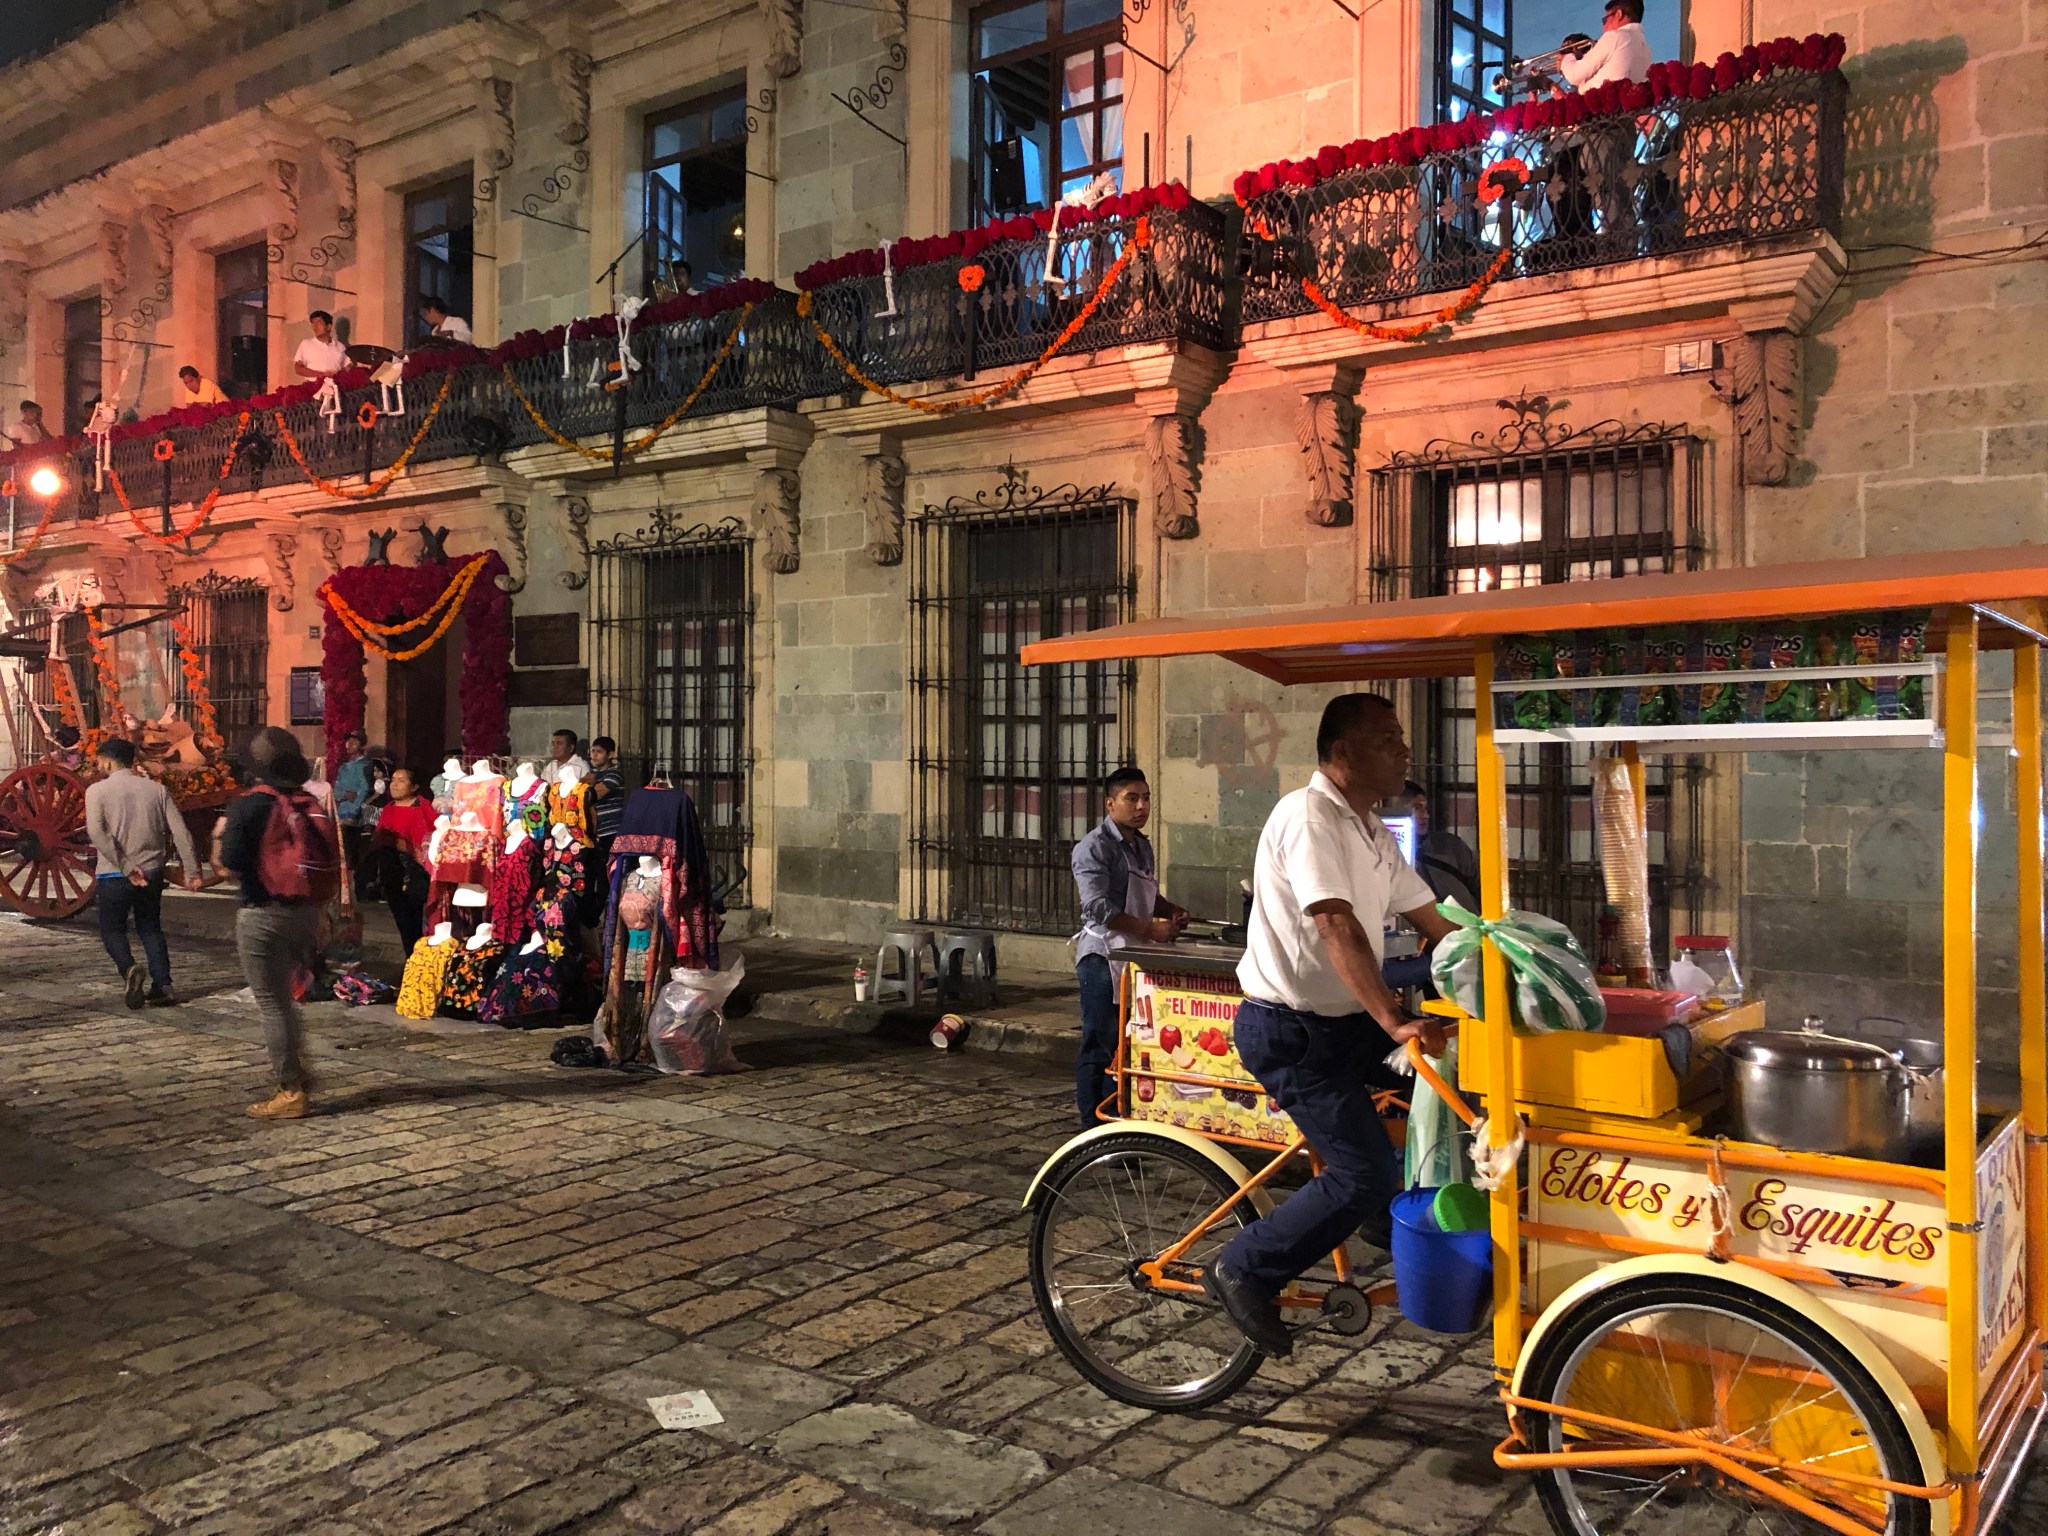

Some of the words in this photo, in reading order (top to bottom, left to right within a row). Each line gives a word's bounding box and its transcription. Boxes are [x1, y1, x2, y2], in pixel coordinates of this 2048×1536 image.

[1144, 969, 1180, 988] RICAS
[1540, 1147, 1670, 1214] Elotes
[1672, 1194, 1707, 1228] y
[1740, 1178, 1943, 1260] Esquites
